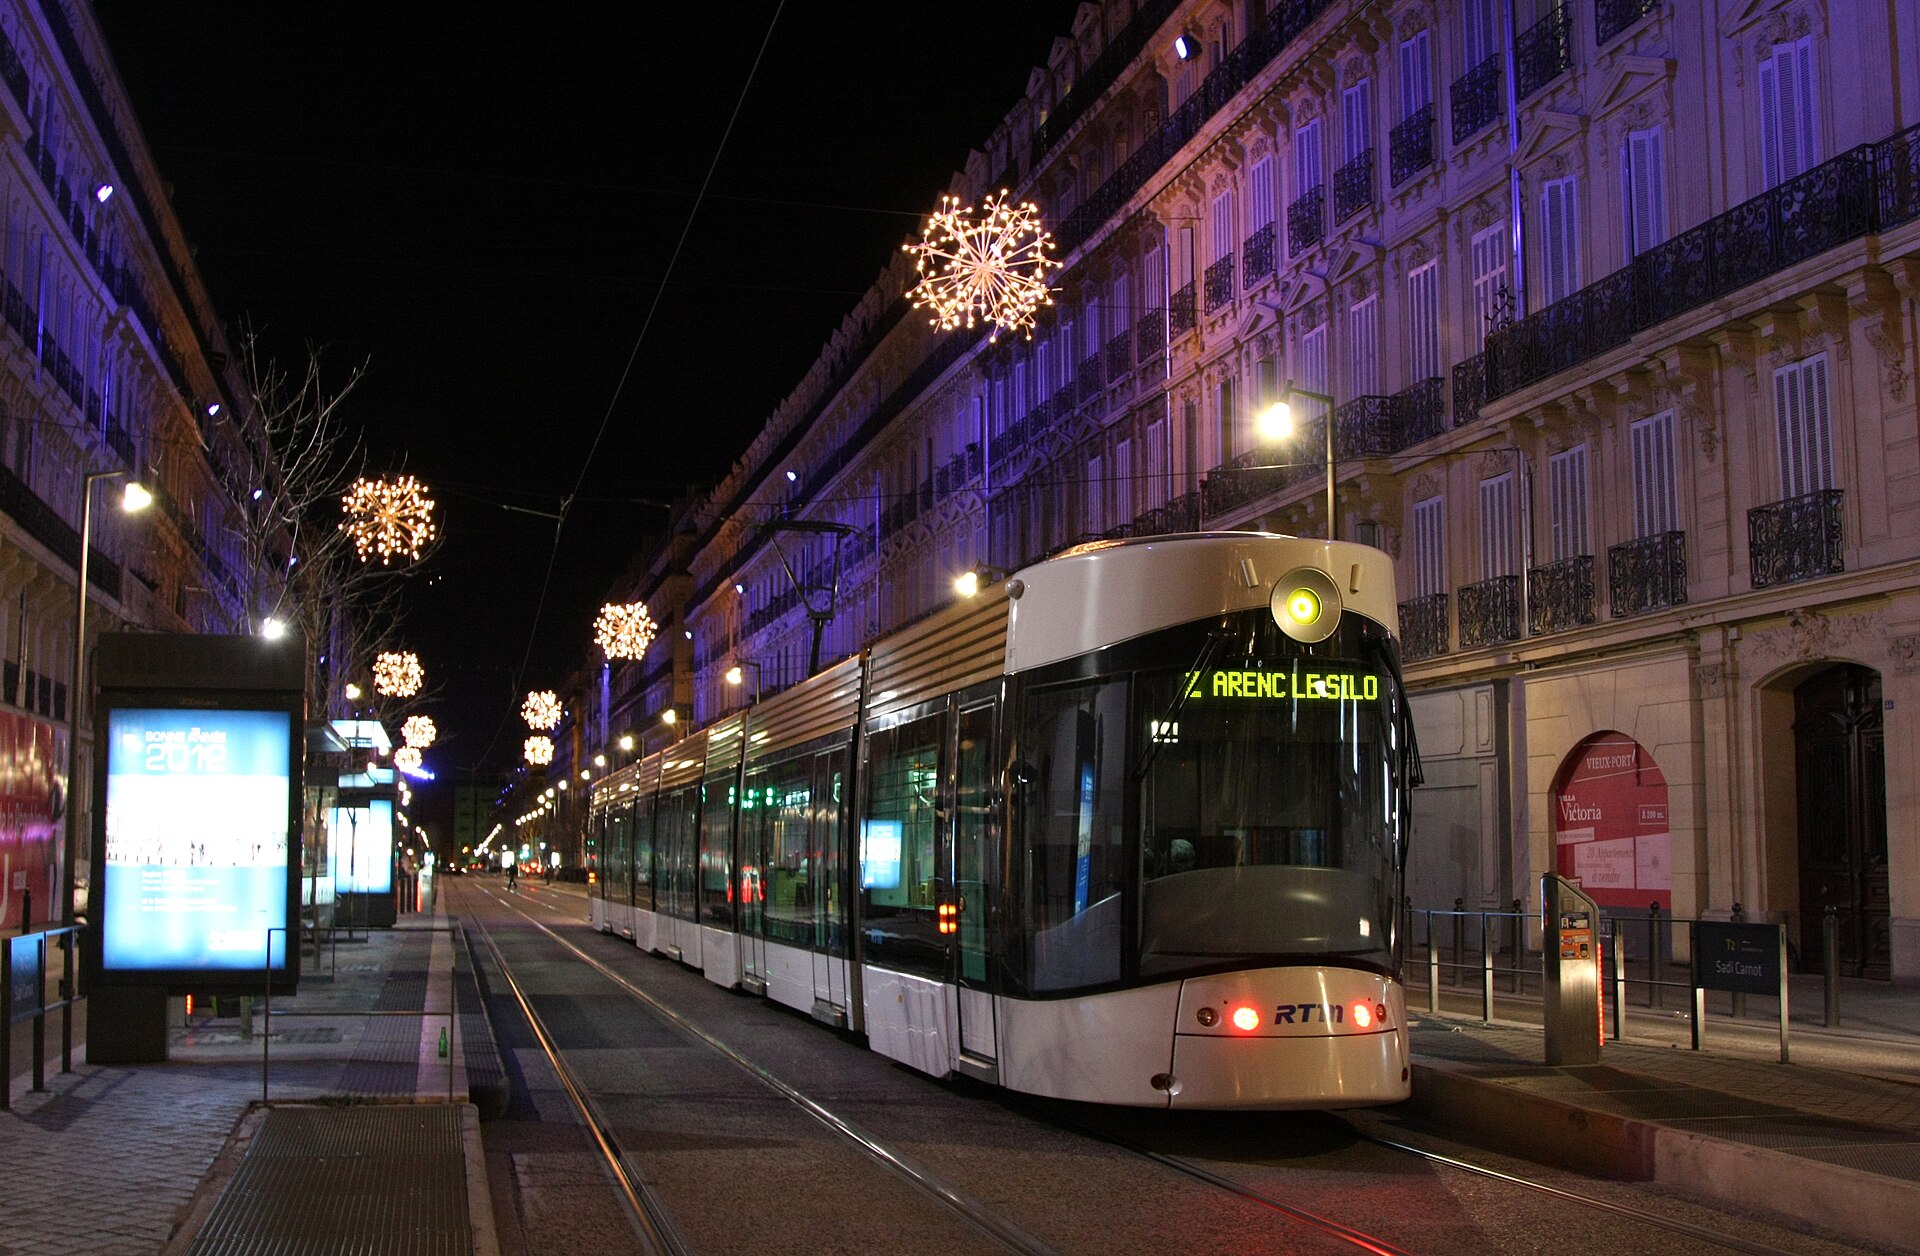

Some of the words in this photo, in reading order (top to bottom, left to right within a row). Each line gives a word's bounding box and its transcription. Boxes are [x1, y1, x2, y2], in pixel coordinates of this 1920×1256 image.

[1213, 671, 1287, 698] ARENC
[1291, 673, 1320, 699] LE
[1326, 674, 1378, 700] SILO
[145, 730, 186, 742] BONNE
[145, 743, 227, 771] 2012
[1559, 802, 1602, 821] Victoria
[1715, 960, 1734, 974] Sadi
[1735, 961, 1762, 977] Carnot
[1274, 1003, 1344, 1025] RTM
